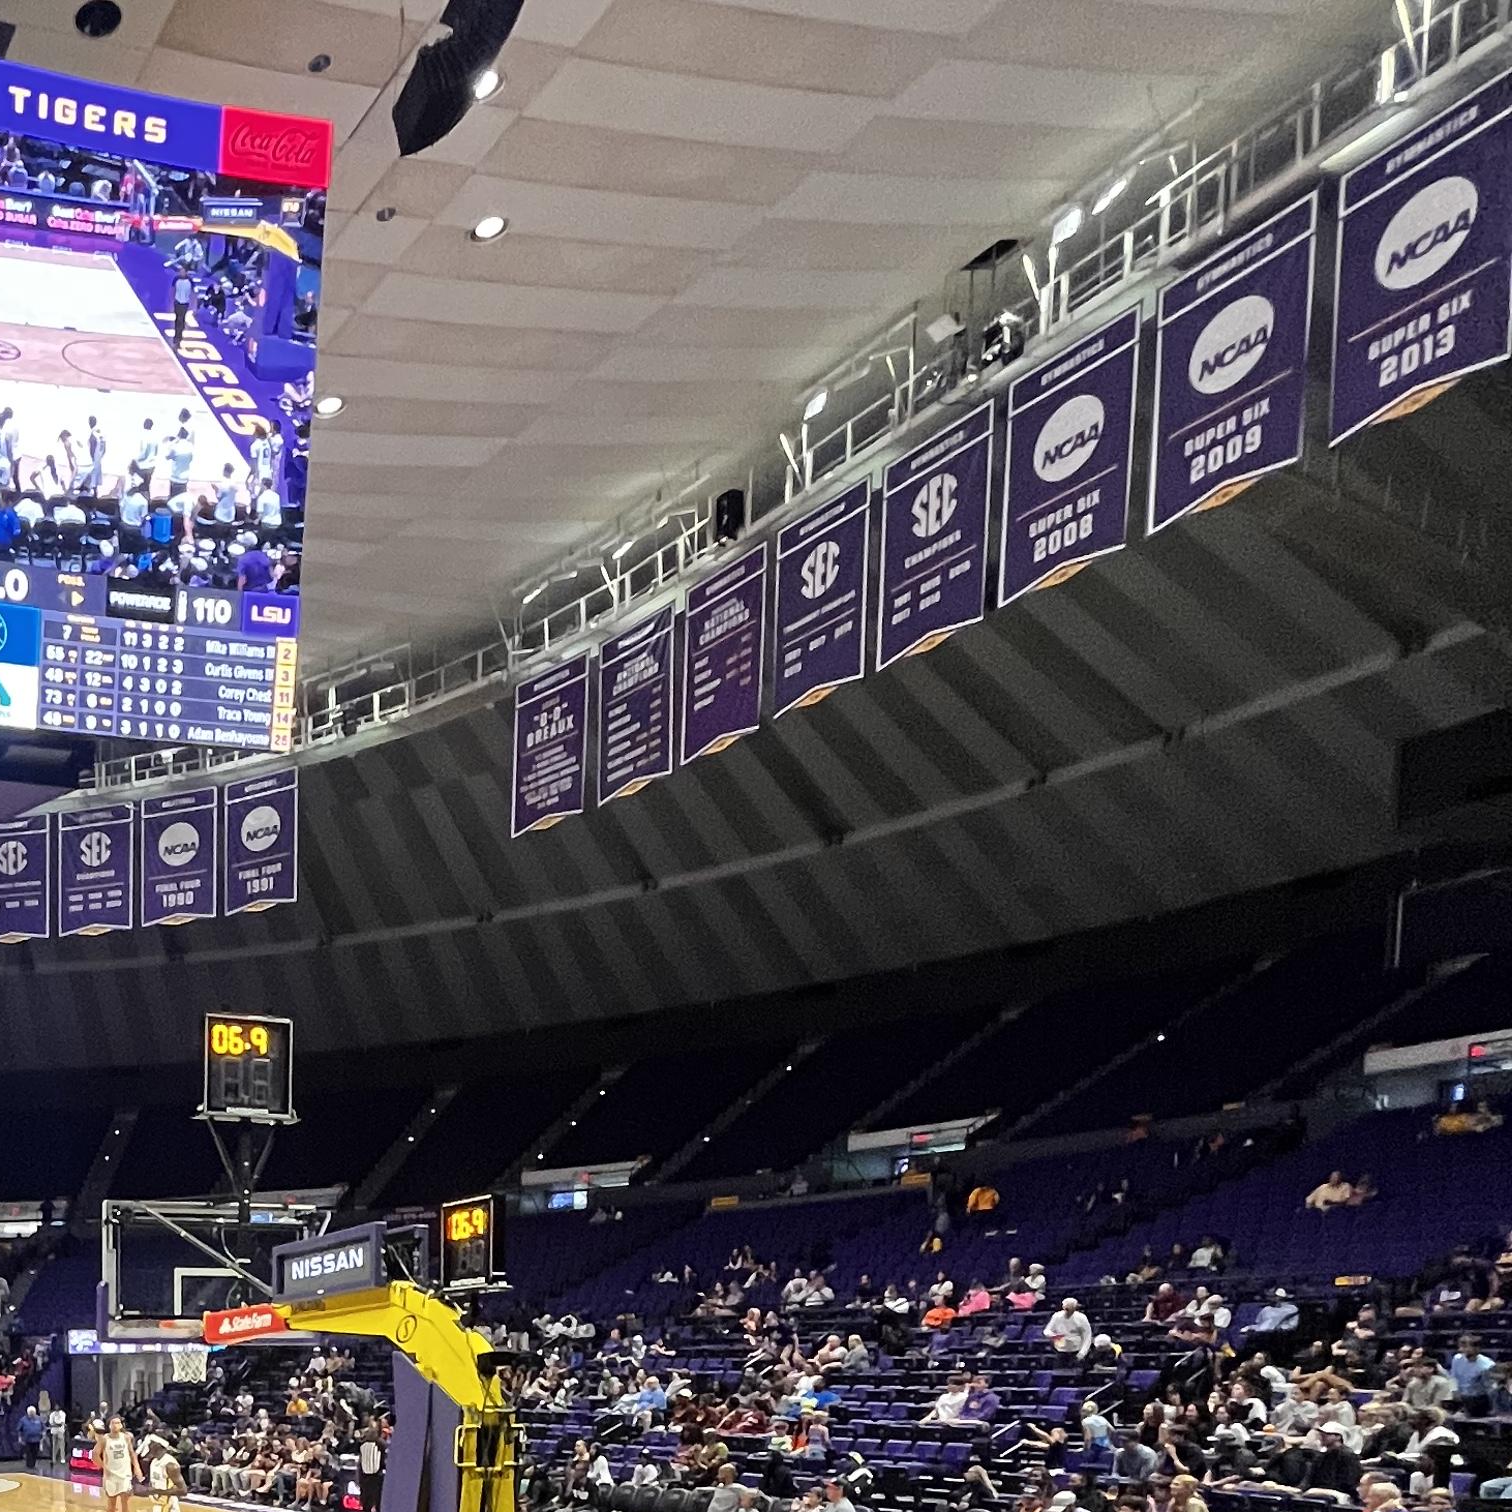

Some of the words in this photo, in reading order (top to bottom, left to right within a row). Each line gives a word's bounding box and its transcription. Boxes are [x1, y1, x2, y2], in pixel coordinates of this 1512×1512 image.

[8, 85, 167, 144] TIGERS
[1385, 208, 1472, 278] NCAA
[1368, 312, 1432, 361] SUPER
[1437, 289, 1473, 324] SIX
[1199, 324, 1269, 383] NCAA
[1378, 324, 1456, 388] 2013
[1184, 416, 1237, 458] SUPER
[1242, 396, 1271, 426] SIX
[1041, 421, 1100, 470] NCAA
[1190, 424, 1262, 485] 2009
[911, 473, 958, 538] SEC
[1029, 504, 1073, 539] SUPER
[1033, 513, 1094, 563] 2008
[801, 541, 840, 599] SEC
[193, 597, 232, 624] 110
[251, 605, 291, 624] LSU
[283, 648, 291, 660] 2
[281, 671, 289, 682] 3
[279, 692, 289, 703] 11
[276, 713, 288, 724] 14
[80, 831, 112, 867] SEC
[163, 842, 197, 856] NCAA
[246, 824, 278, 842] NCAA
[210, 1024, 268, 1055] 06.9
[291, 1248, 364, 1280] NISSAN
